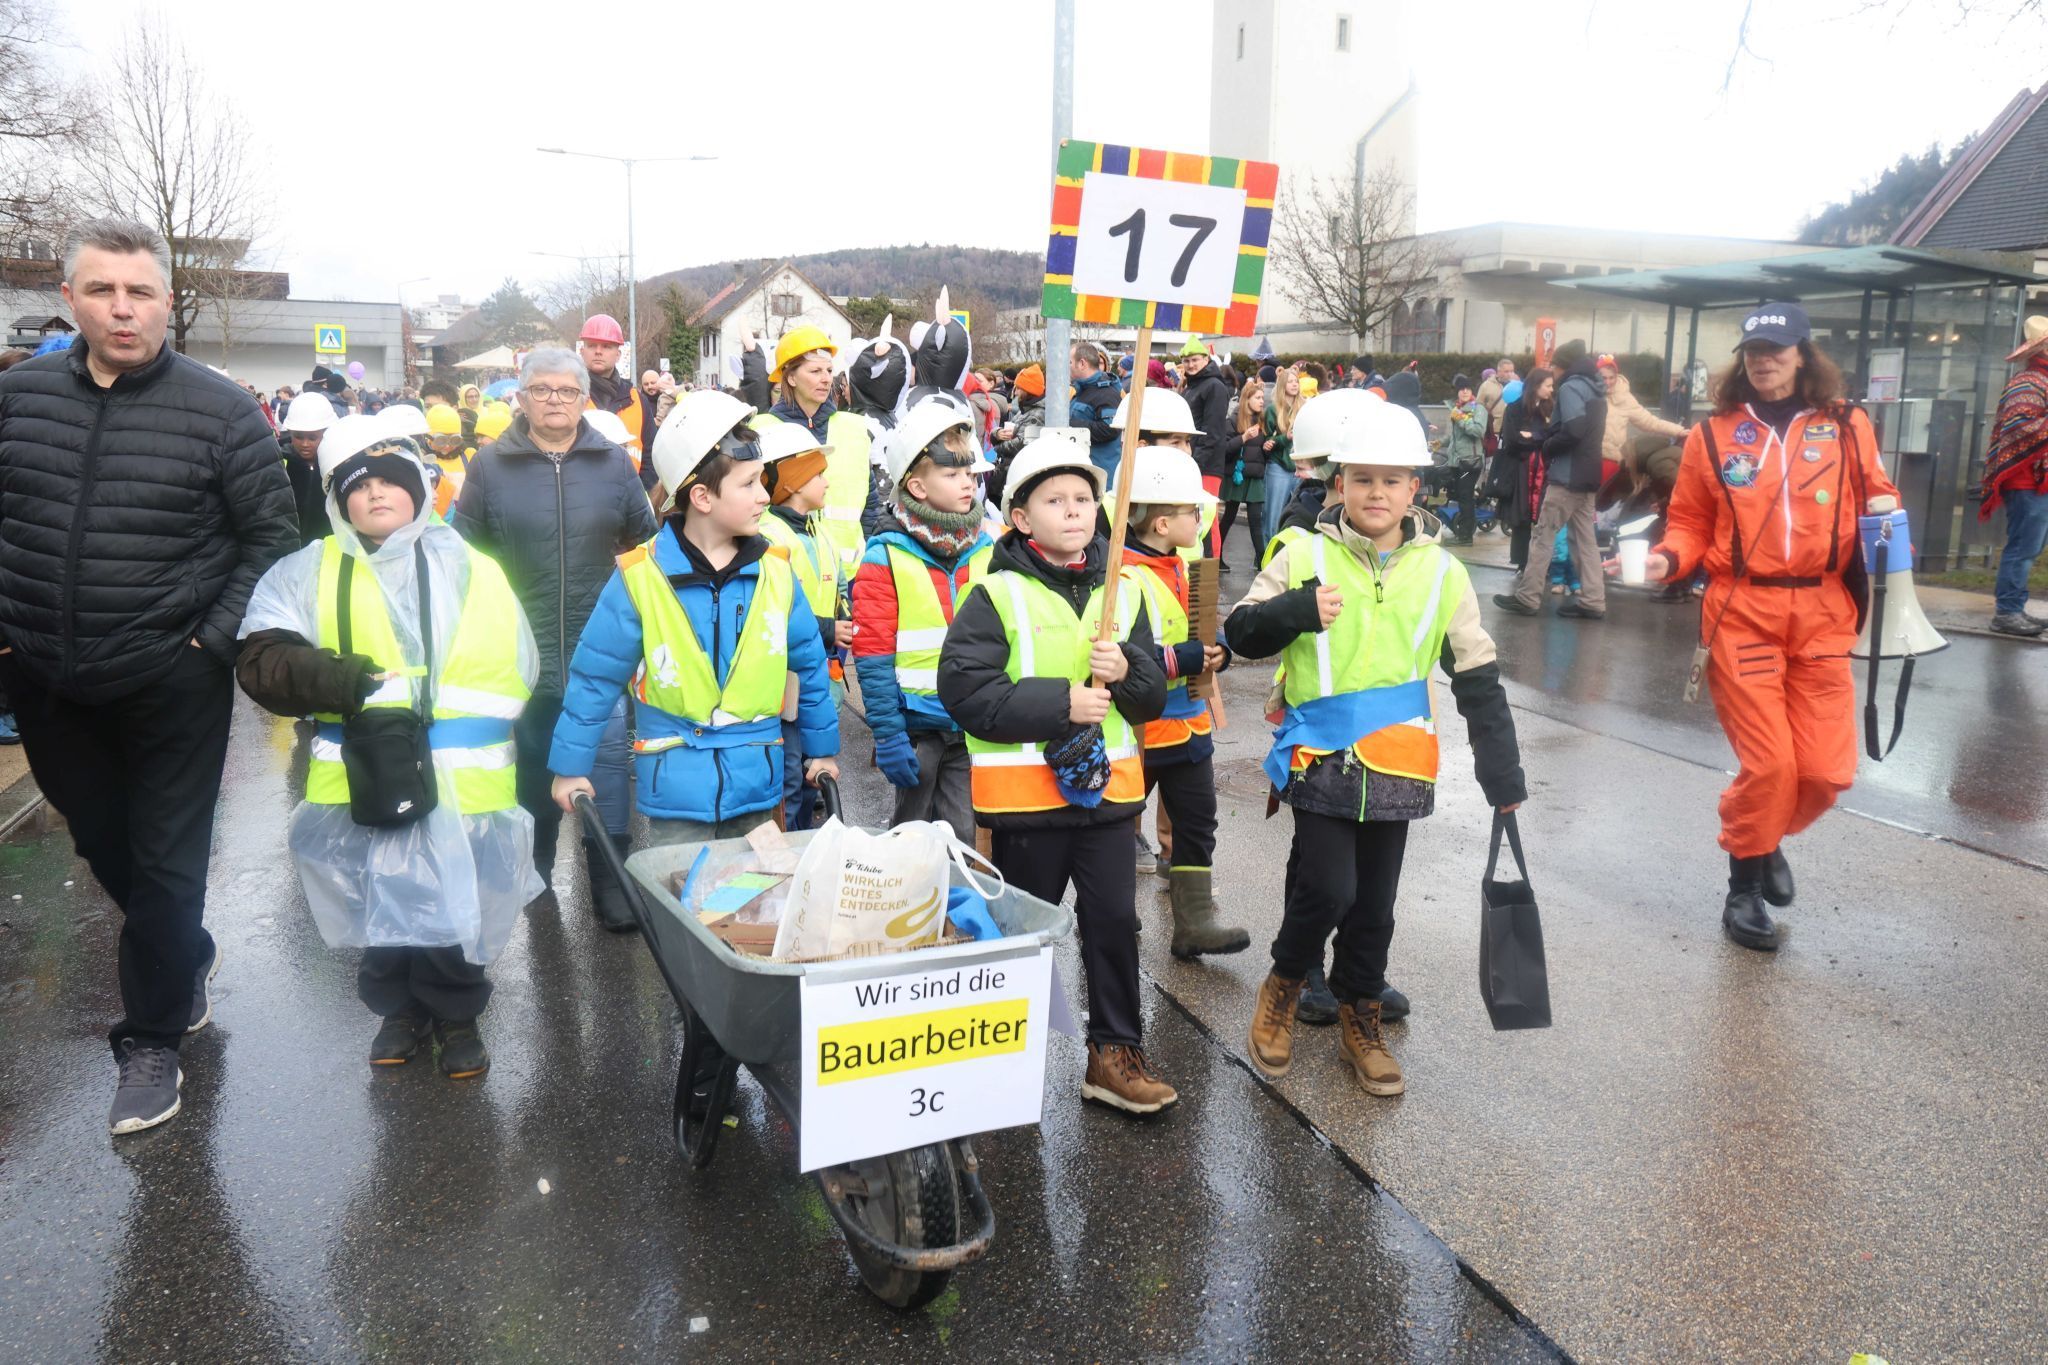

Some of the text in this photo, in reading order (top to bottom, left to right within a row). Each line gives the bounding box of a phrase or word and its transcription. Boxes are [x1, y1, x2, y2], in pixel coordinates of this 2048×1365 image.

[1109, 208, 1217, 287] 17
[1760, 315, 1787, 326] esa
[857, 863, 884, 874] Tchibo
[844, 873, 903, 888] WIRKLICH
[842, 886, 882, 899] GUTES
[840, 898, 910, 911] ENTDECKEN.
[855, 968, 1006, 1008] Wir sind die
[820, 1018, 1028, 1074] Bauarbeiter
[909, 1088, 945, 1117] 3c
